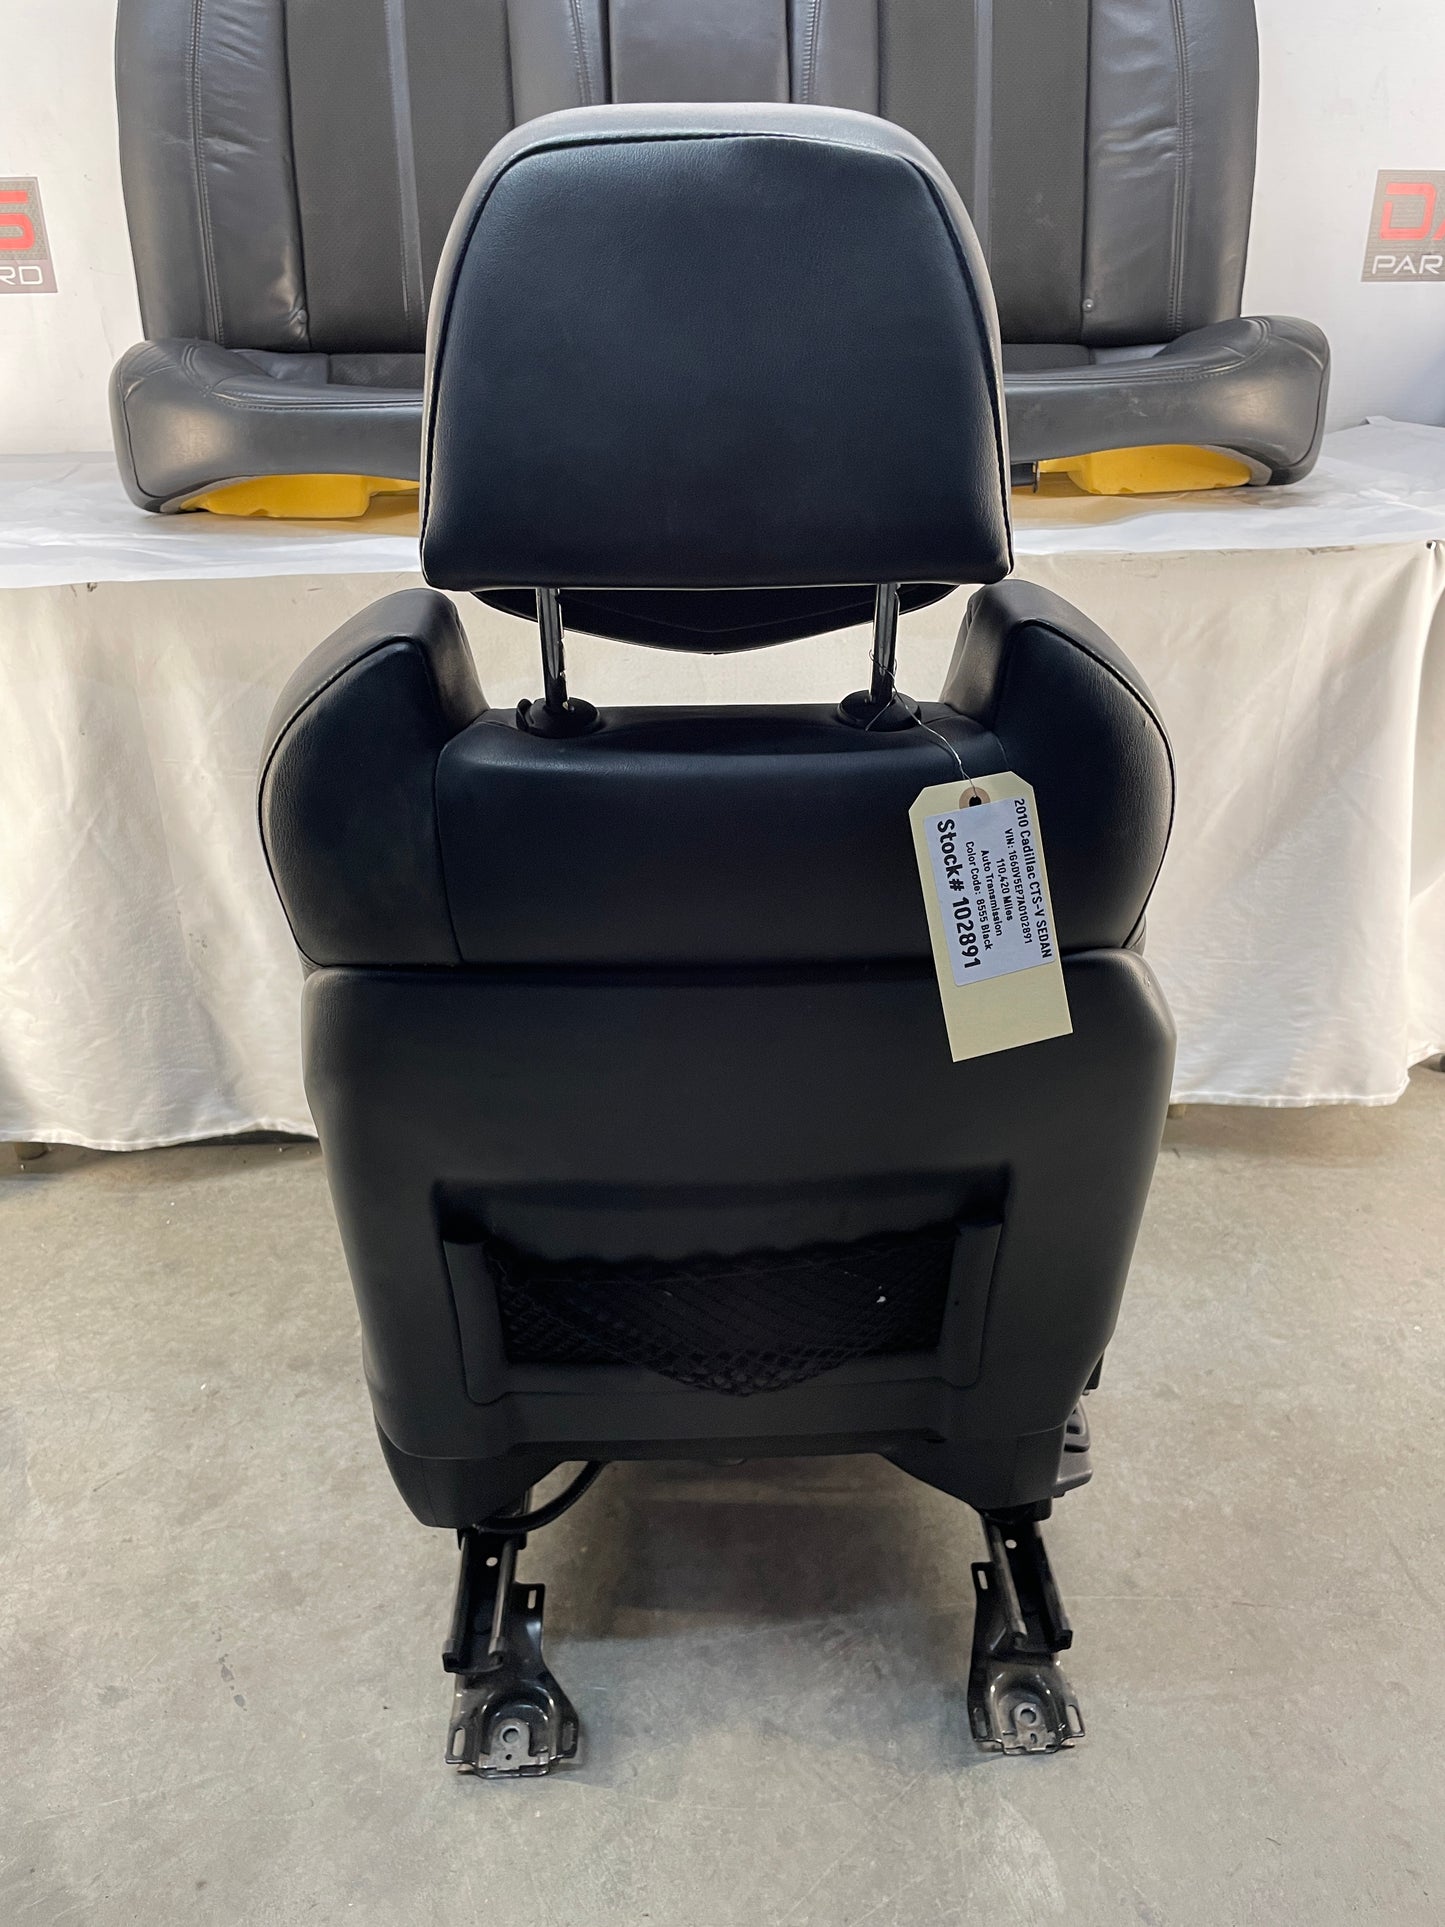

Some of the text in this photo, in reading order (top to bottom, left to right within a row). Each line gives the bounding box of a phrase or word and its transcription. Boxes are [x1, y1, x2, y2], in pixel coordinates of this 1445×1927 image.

[1380, 183, 1445, 240] D
[1372, 255, 1443, 274] PAR
[937, 819, 981, 969] Stock# 102891
[965, 841, 993, 951] Color Code: 8555 Black
[980, 850, 1003, 937] Auto Transmission
[996, 858, 1014, 921] 110,420 Miles
[1004, 828, 1033, 944] VIN: 1G6DV5EP7A0102891
[1014, 798, 1052, 958] 2010 Cadillac CTS-V SEDAN
